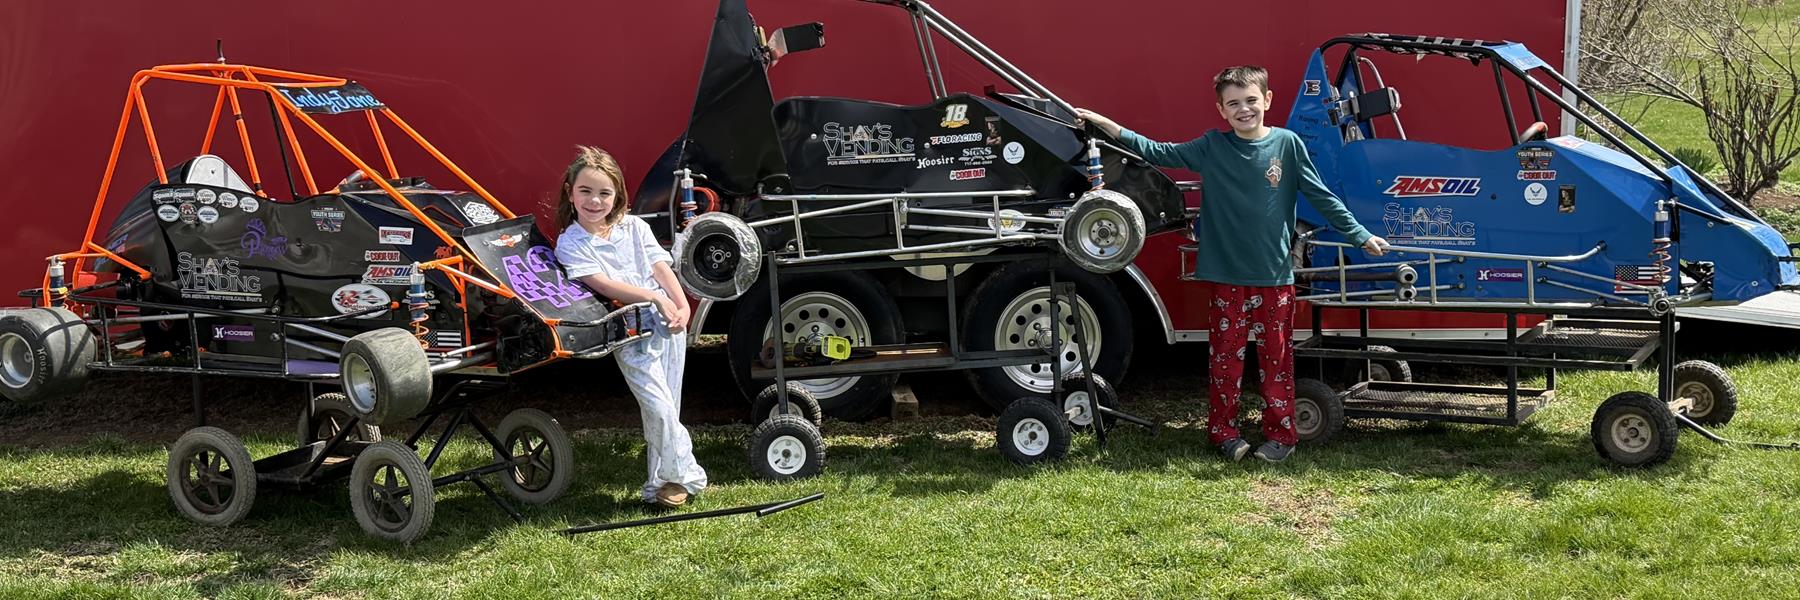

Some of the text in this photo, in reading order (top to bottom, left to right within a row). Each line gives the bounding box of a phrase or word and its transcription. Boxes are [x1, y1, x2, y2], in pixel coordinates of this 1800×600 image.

[944, 104, 968, 122] 18
[823, 122, 893, 141] SHAY'S
[822, 137, 915, 157] VENDING
[1386, 177, 1480, 195] AMSOIL
[1384, 202, 1453, 222] SHAY'S
[1383, 218, 1475, 238] VENDING
[177, 252, 241, 275] SHAY'S
[366, 266, 412, 279] AMSOIL
[177, 269, 262, 293] VENDING
